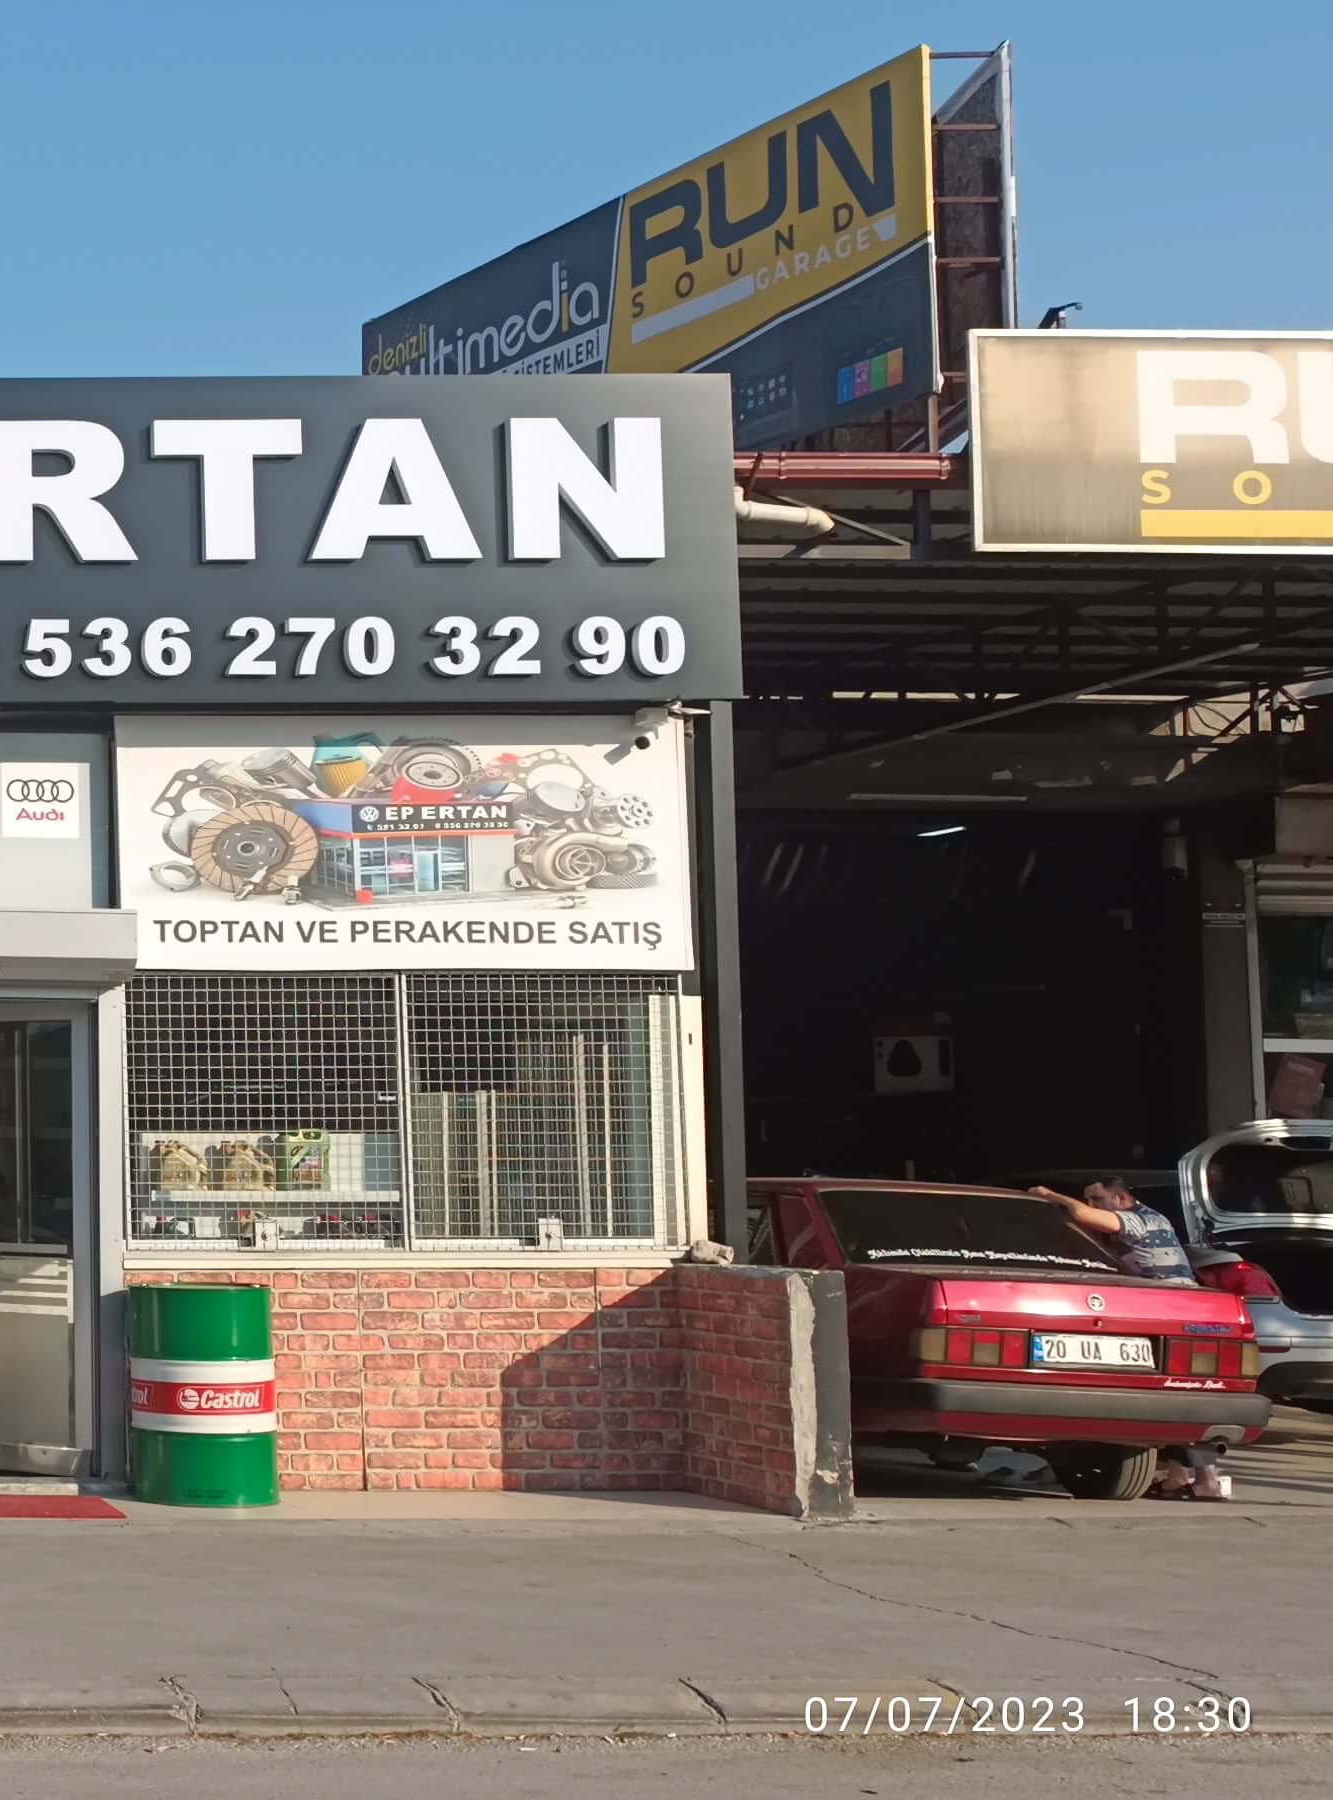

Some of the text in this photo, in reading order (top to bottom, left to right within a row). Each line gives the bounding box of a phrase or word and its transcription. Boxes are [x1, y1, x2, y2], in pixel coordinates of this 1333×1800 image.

[629, 80, 895, 289] RUN
[755, 226, 870, 291] GARAGE
[367, 322, 427, 376] denizli
[21, 616, 192, 677] 536
[226, 615, 397, 677] 270
[428, 615, 542, 676] 32
[575, 615, 687, 677] 90
[15, 808, 65, 822] Audi
[385, 805, 507, 820] EP ERTAN
[153, 920, 663, 951] TOPTAN VE PERAKENDE SATIŞ
[1044, 1339, 1151, 1363] 20 UA 630
[200, 1388, 261, 1409] Castrol
